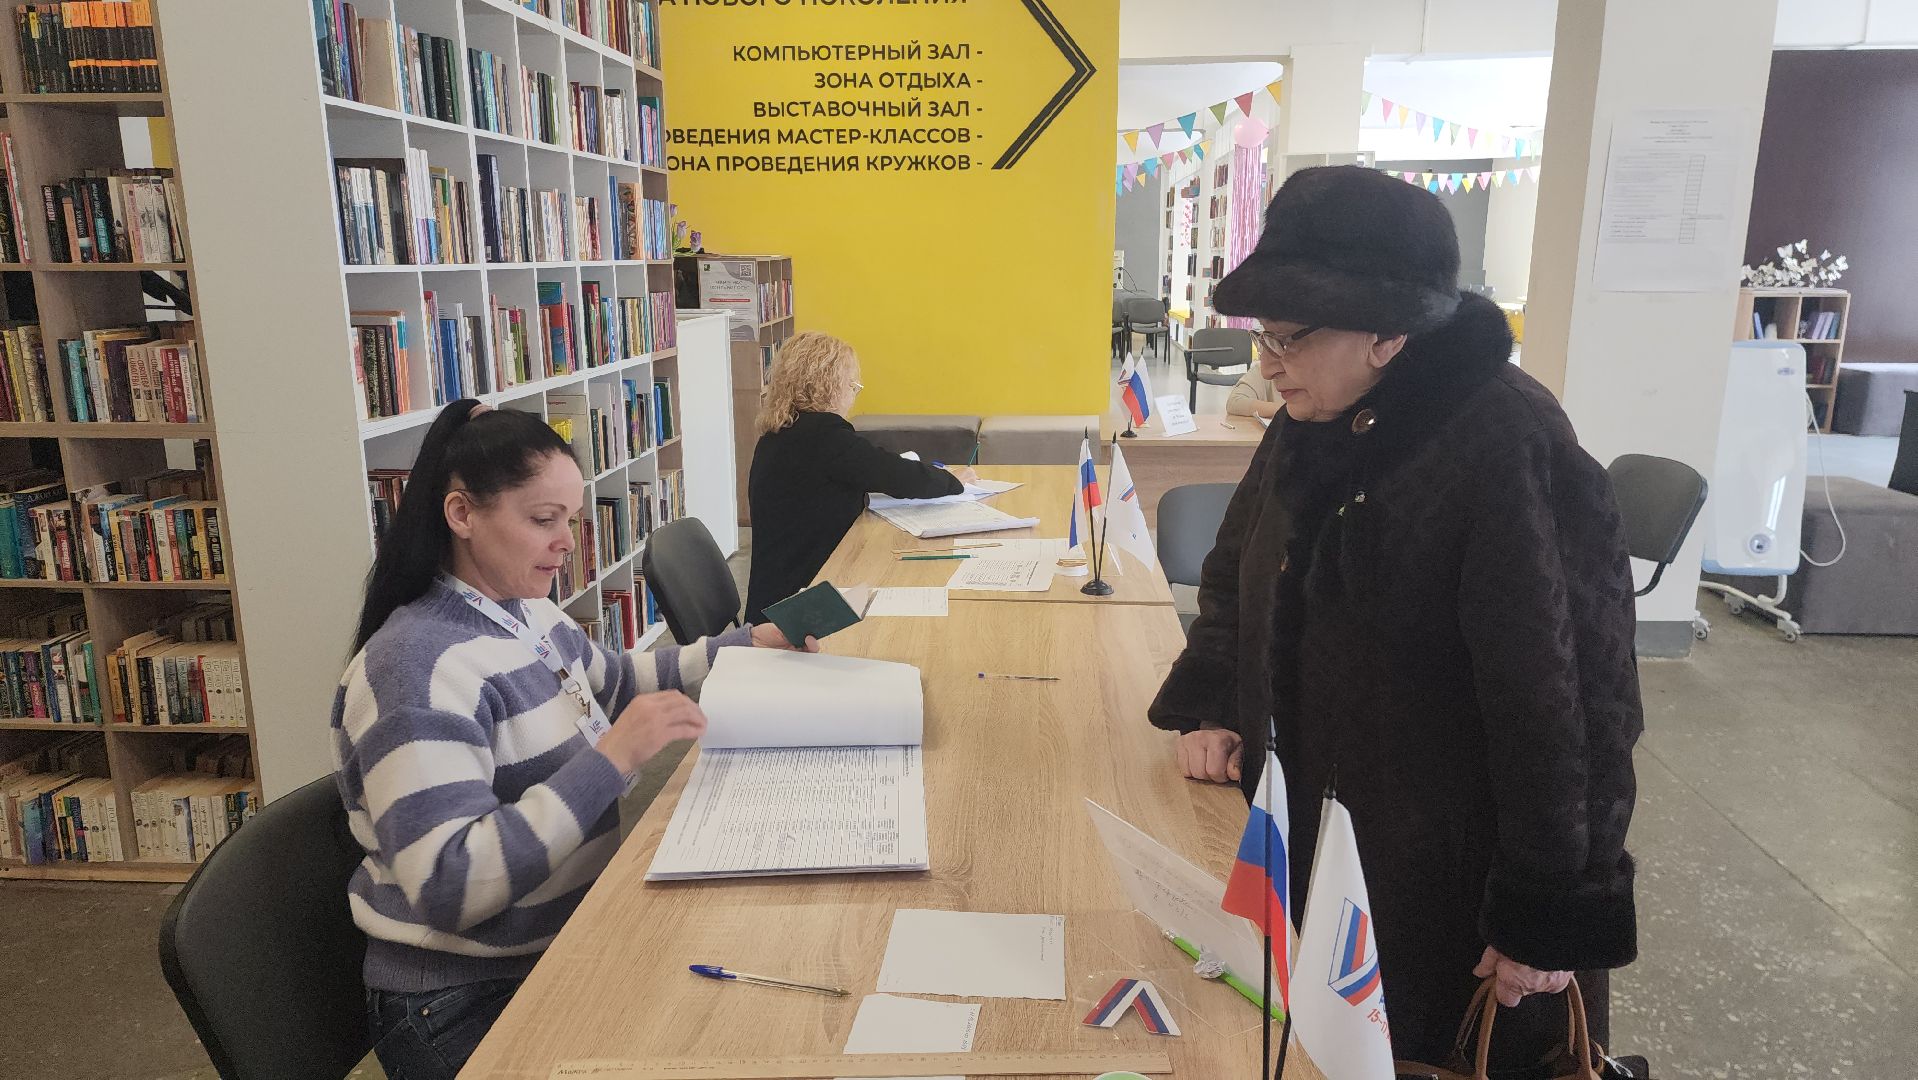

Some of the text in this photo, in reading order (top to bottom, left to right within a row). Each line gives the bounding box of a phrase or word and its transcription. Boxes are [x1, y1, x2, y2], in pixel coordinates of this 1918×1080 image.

[733, 40, 921, 62] КОМПЬЮТЕРНЫЙ
[927, 43, 970, 60] ЗАЛ
[814, 72, 874, 89] ЗОНА
[878, 72, 972, 92] ОТДЫХА
[753, 97, 921, 118] ВЫСТАВОЧНЫЙ
[927, 100, 970, 118] ЗАЛ
[777, 128, 971, 145] МАСТЕР-КЛАССОВ
[716, 155, 860, 175] ПРОВЕДЕНИЯ
[866, 154, 971, 172] КРУЖКОВ
